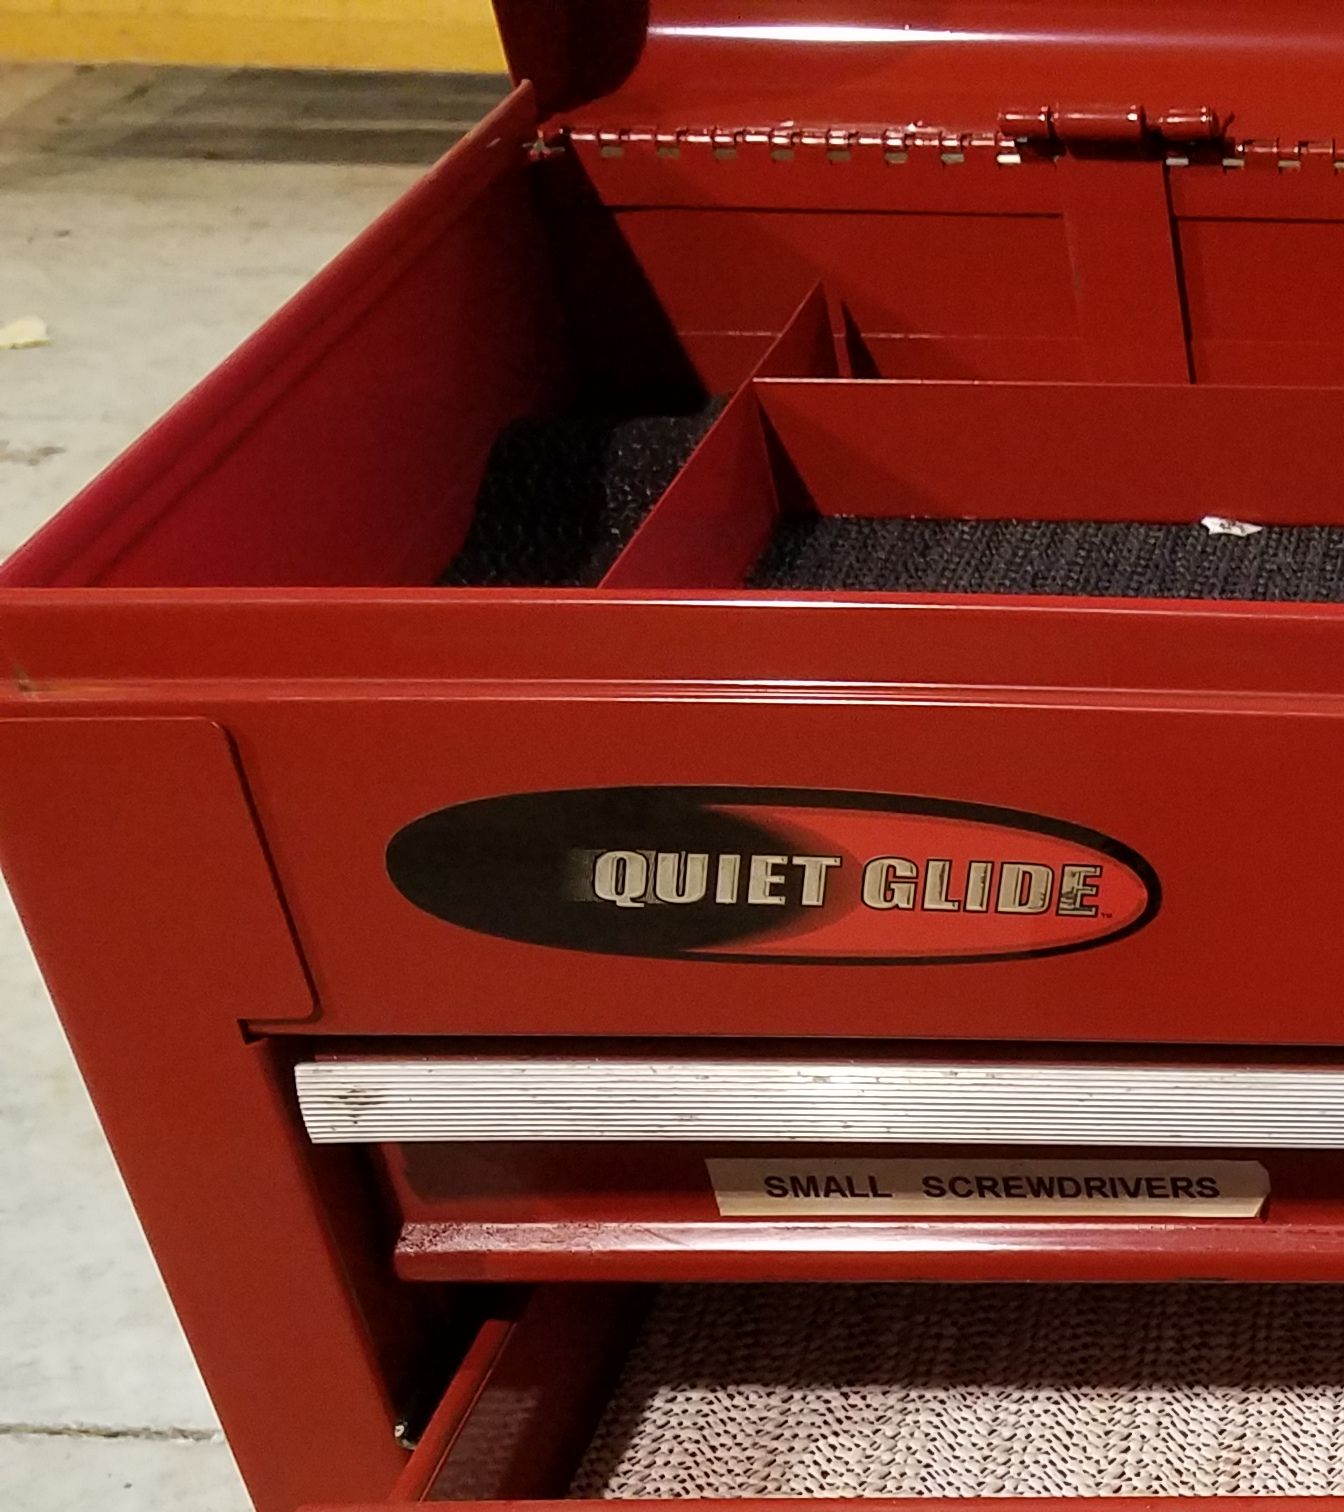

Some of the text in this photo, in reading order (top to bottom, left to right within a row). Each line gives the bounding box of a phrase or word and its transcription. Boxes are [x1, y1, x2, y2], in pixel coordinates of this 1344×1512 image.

[593, 850, 843, 907] QUIET
[861, 856, 1103, 918] GLIDE
[763, 1174, 1221, 1199] SMALL SCREWDRIVERS
